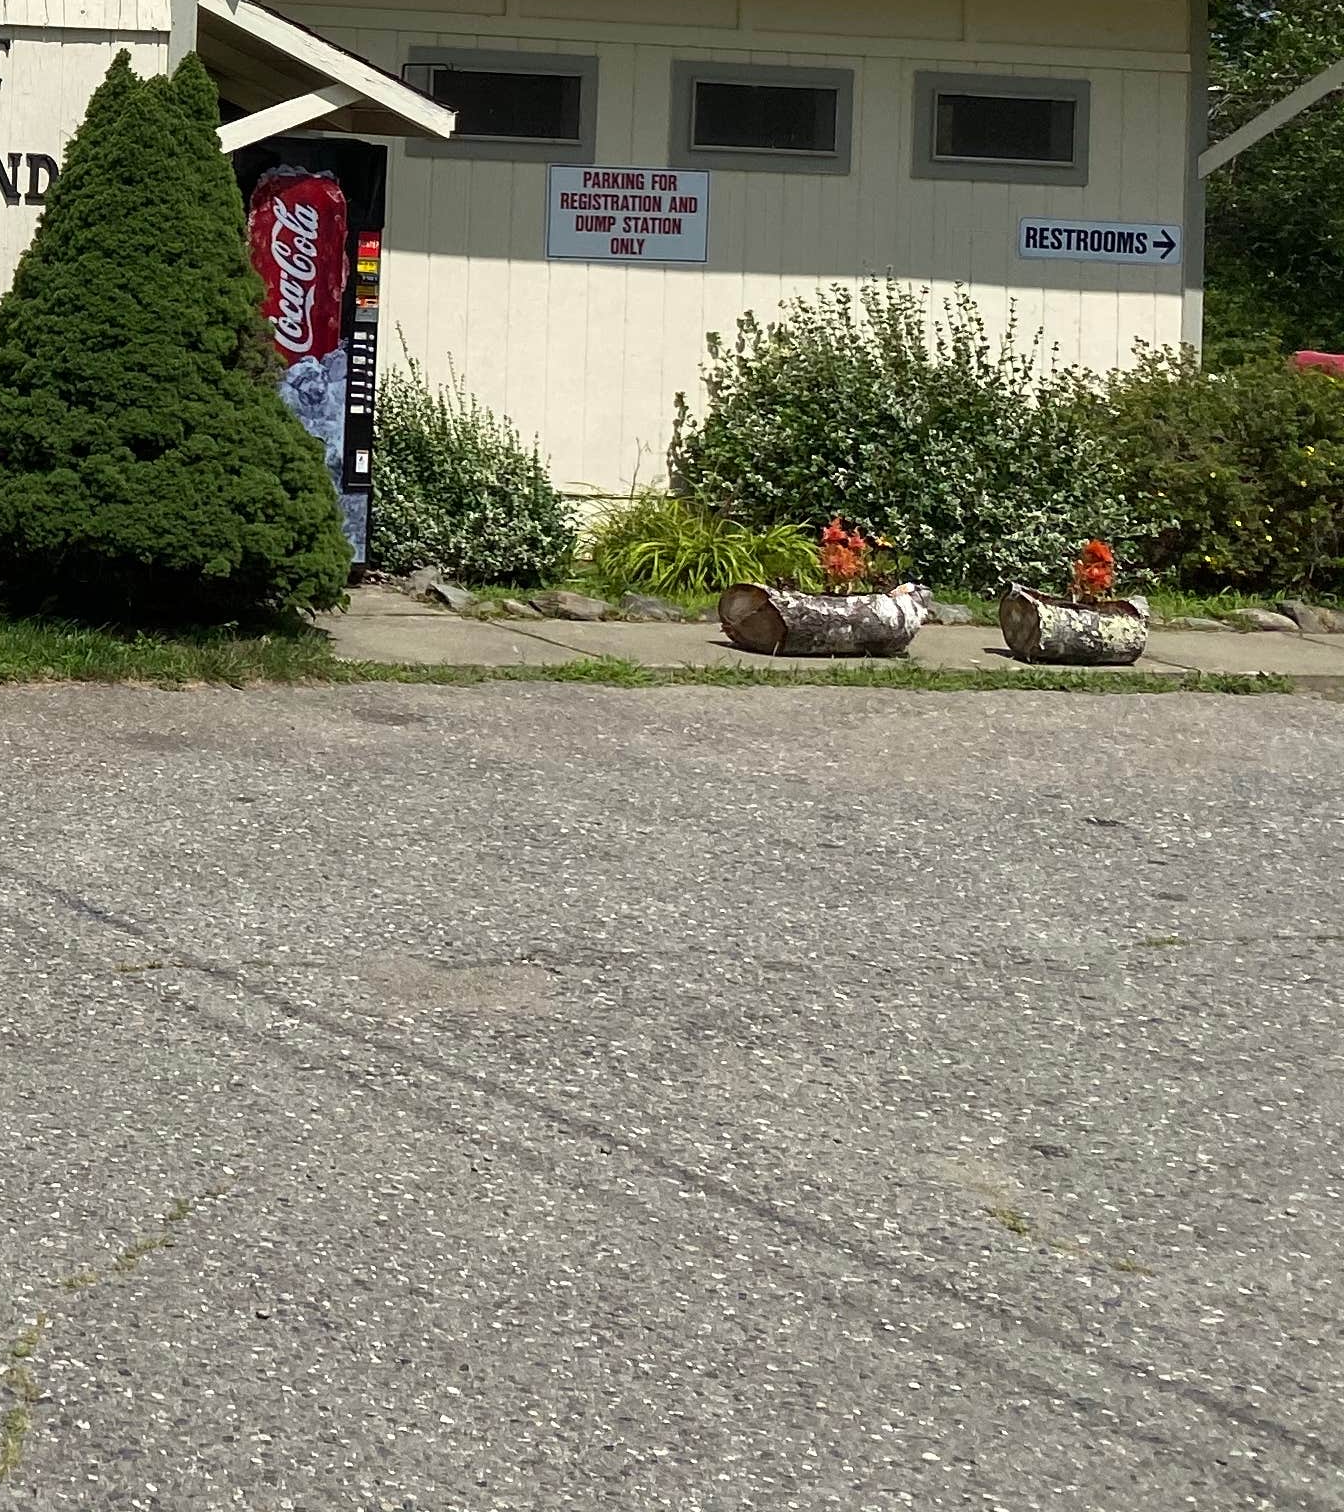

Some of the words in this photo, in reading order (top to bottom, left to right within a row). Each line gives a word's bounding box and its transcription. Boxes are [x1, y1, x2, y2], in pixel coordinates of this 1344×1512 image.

[583, 171, 644, 190] PARKING
[652, 174, 677, 192] FOR
[560, 192, 662, 212] REGISTRATION
[669, 196, 698, 213] AND
[575, 214, 616, 232] DUMP
[622, 216, 682, 235] STATION
[610, 238, 646, 256] ONLY
[1025, 226, 1148, 254] RESTROOMS
